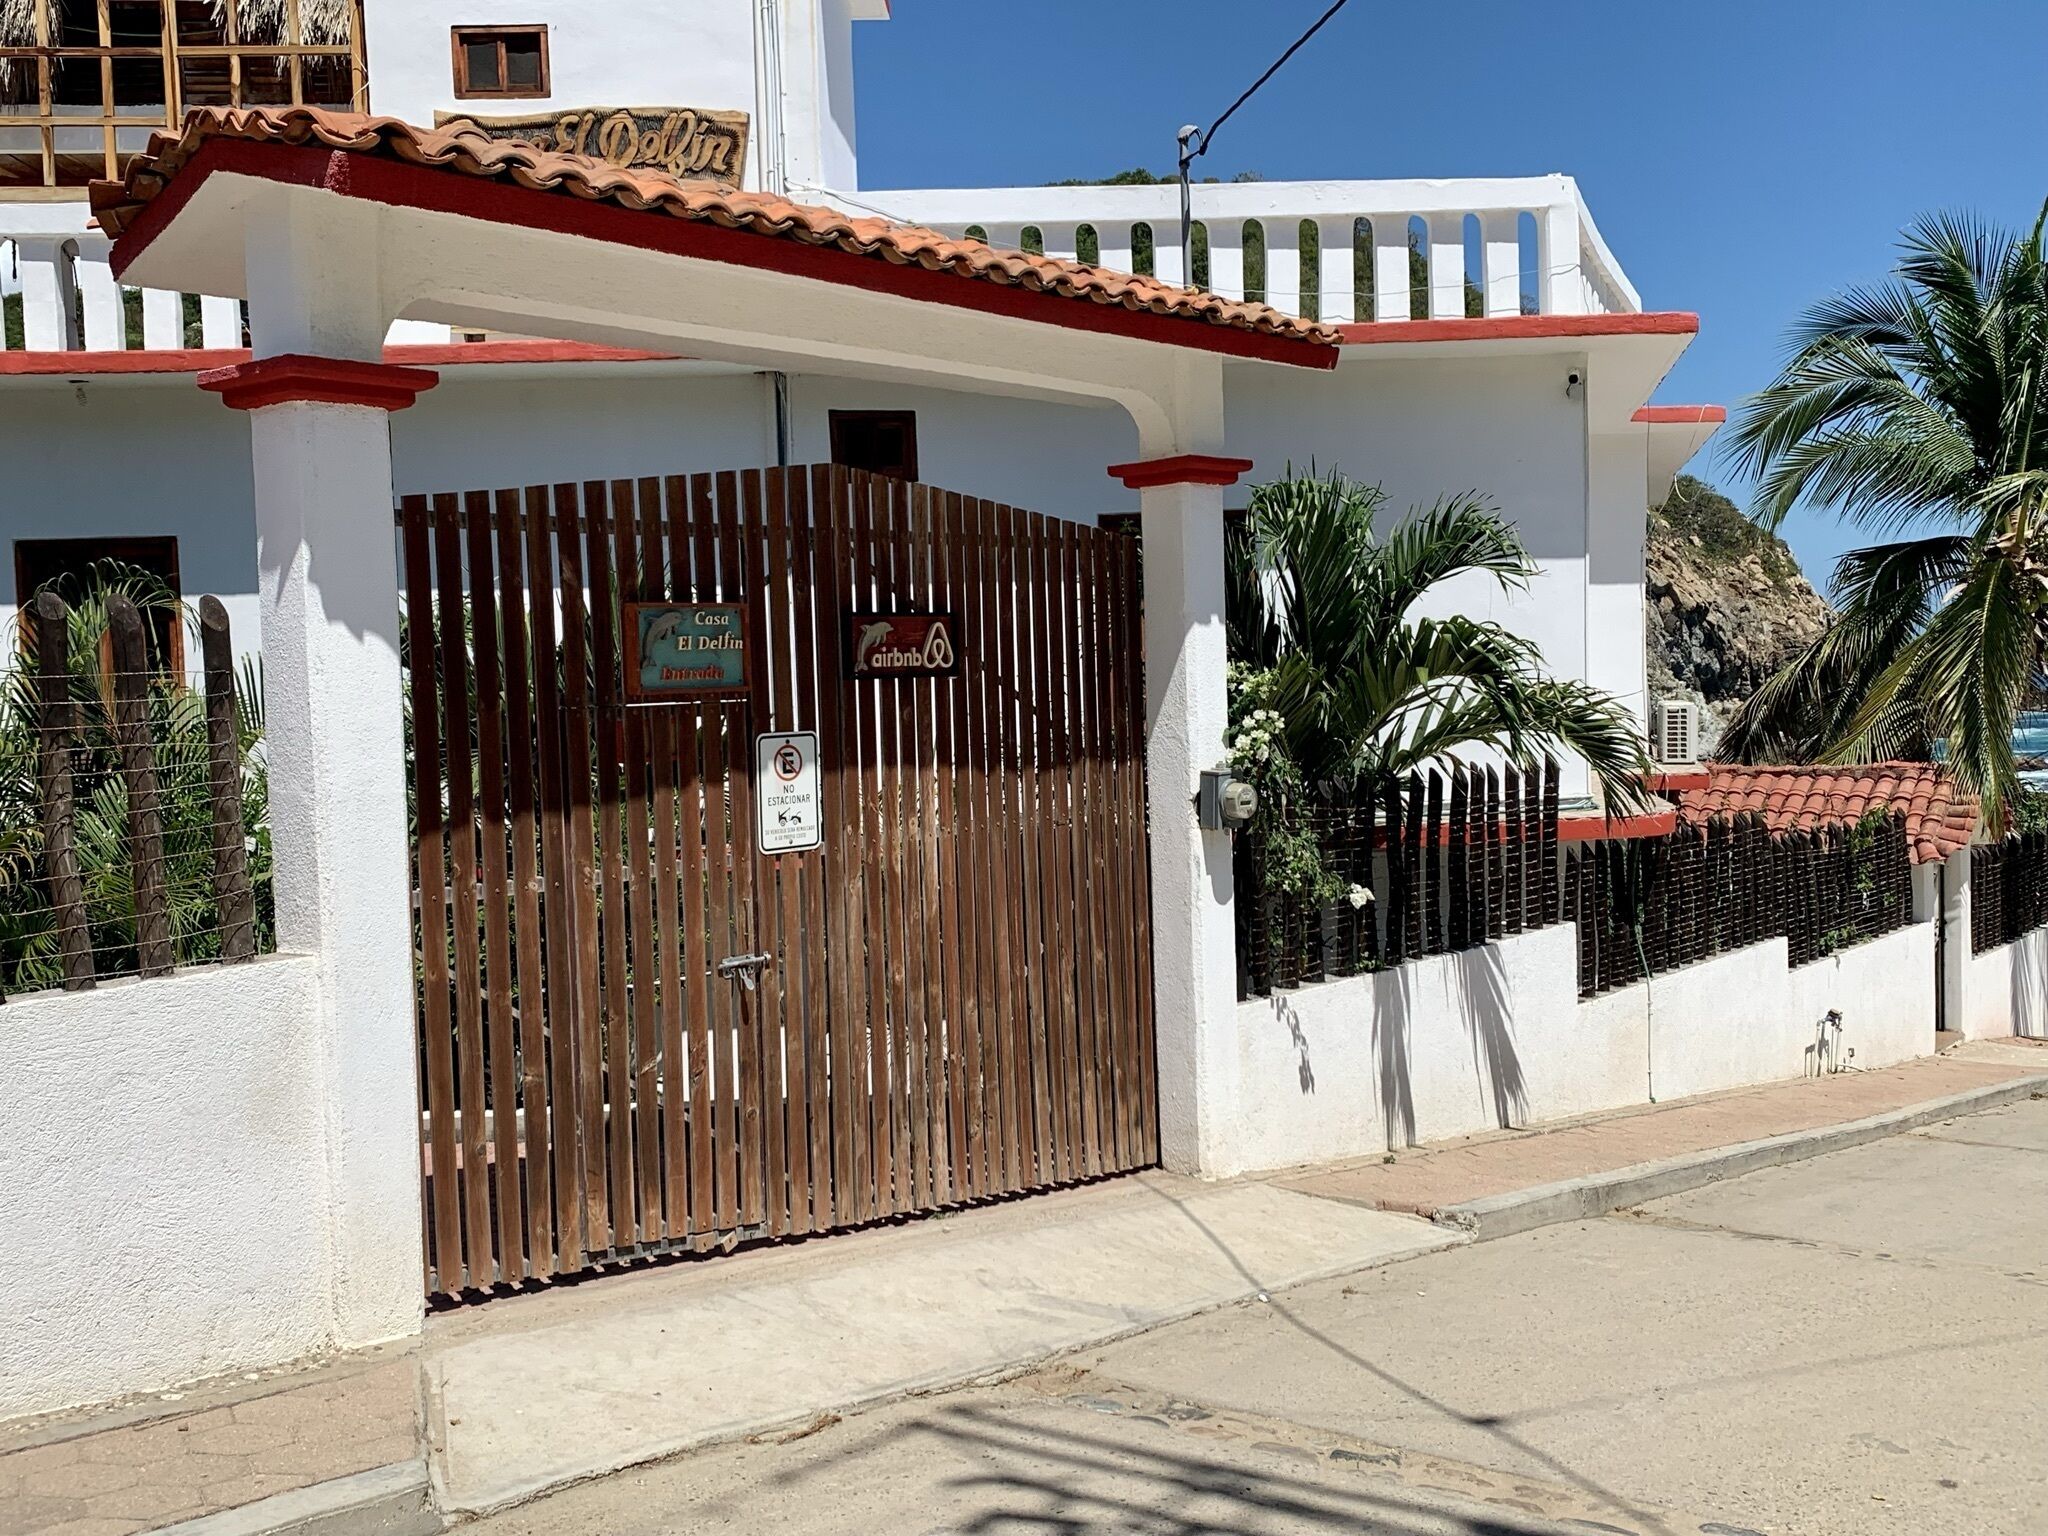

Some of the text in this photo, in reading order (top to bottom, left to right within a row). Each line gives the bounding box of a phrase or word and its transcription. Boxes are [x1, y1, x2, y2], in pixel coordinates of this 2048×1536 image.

[695, 611, 729, 625] Casa
[678, 630, 744, 650] El Delfin
[871, 646, 922, 668] airbnb
[783, 784, 795, 794] NO
[767, 793, 811, 807] ESTACIONAR
